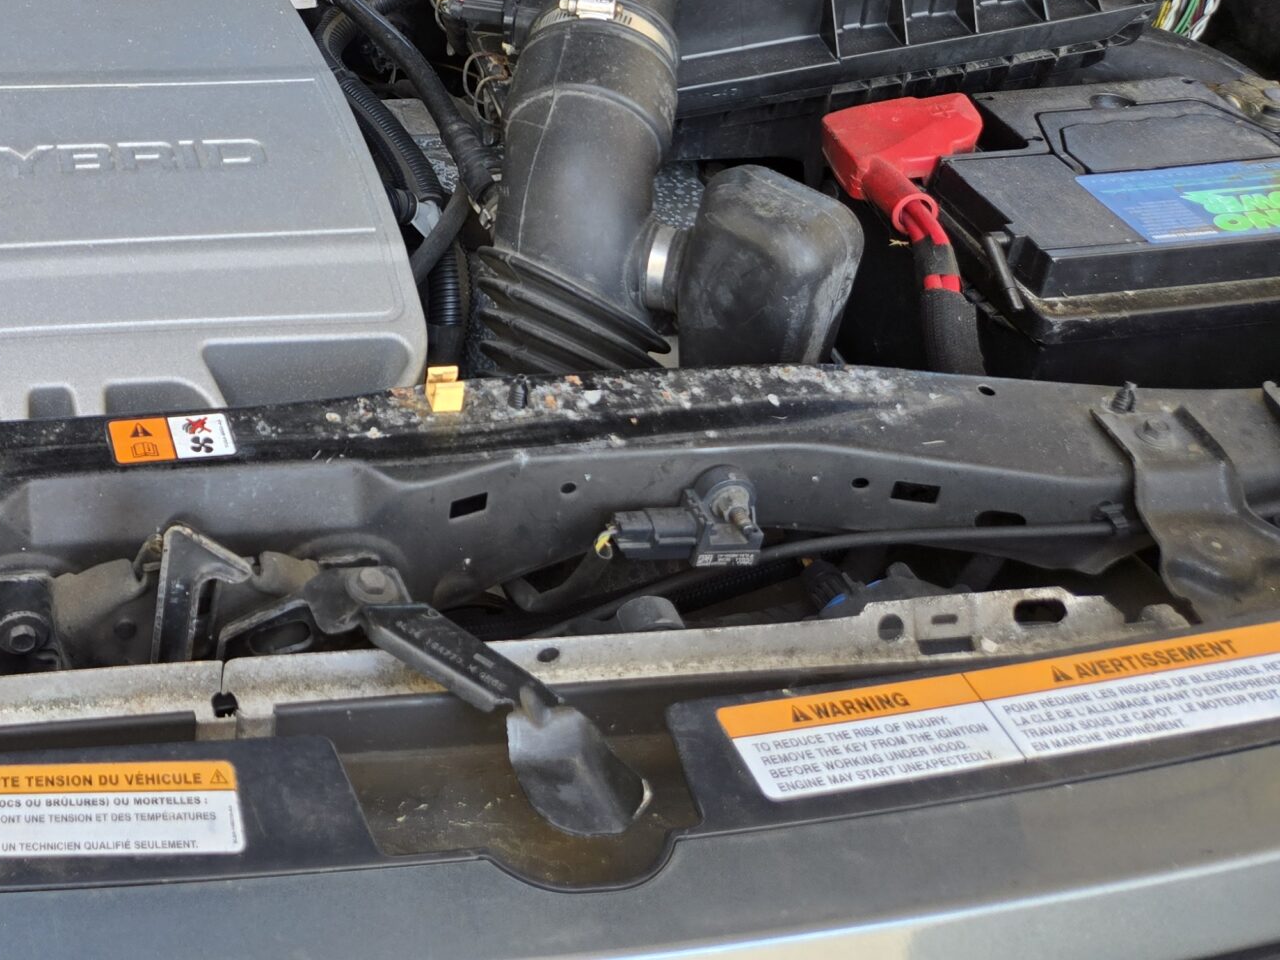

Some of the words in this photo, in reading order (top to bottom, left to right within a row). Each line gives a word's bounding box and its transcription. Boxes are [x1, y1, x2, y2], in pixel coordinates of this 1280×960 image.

[1074, 639, 1240, 679] AVERTISSEMENT
[807, 692, 911, 721] WARNING
[752, 742, 772, 753] TO
[774, 734, 826, 751] REDUCE
[827, 730, 852, 744] THE
[854, 726, 880, 739] RISK
[884, 722, 901, 734] OF
[760, 750, 816, 766] REMOVE
[819, 746, 844, 759] THE
[848, 741, 871, 754] KEY
[874, 736, 908, 750] FROM
[910, 732, 934, 745] THE
[936, 722, 990, 740] IGNITION
[770, 762, 822, 779] BEFORE
[823, 754, 883, 772] WORKING
[886, 746, 928, 762] UNDER
[930, 740, 970, 756] HOOD.
[777, 776, 830, 792] ENGINE
[832, 771, 857, 784] MAY
[859, 765, 900, 780] START
[900, 750, 996, 775] UNEXPECTEDLY.
[24, 774, 93, 788] TENSION
[99, 774, 119, 786] DU
[124, 770, 202, 786] VÉHICULE
[0, 814, 22, 824] ONT
[24, 814, 45, 823] UNE
[48, 813, 92, 822] TENSION
[95, 812, 108, 822] ET
[111, 812, 132, 822] DES
[134, 810, 216, 821] TEMPÉRATURES
[25, 798, 42, 808] OU
[45, 796, 110, 808] BRÛLURES)
[113, 797, 130, 806] OU
[134, 796, 201, 806] MORTELLES
[2, 842, 16, 852] UN
[19, 841, 81, 851] TECHNICIEN
[84, 839, 131, 850] QUALIFIÉ
[134, 840, 198, 850] SEULEMENT.
